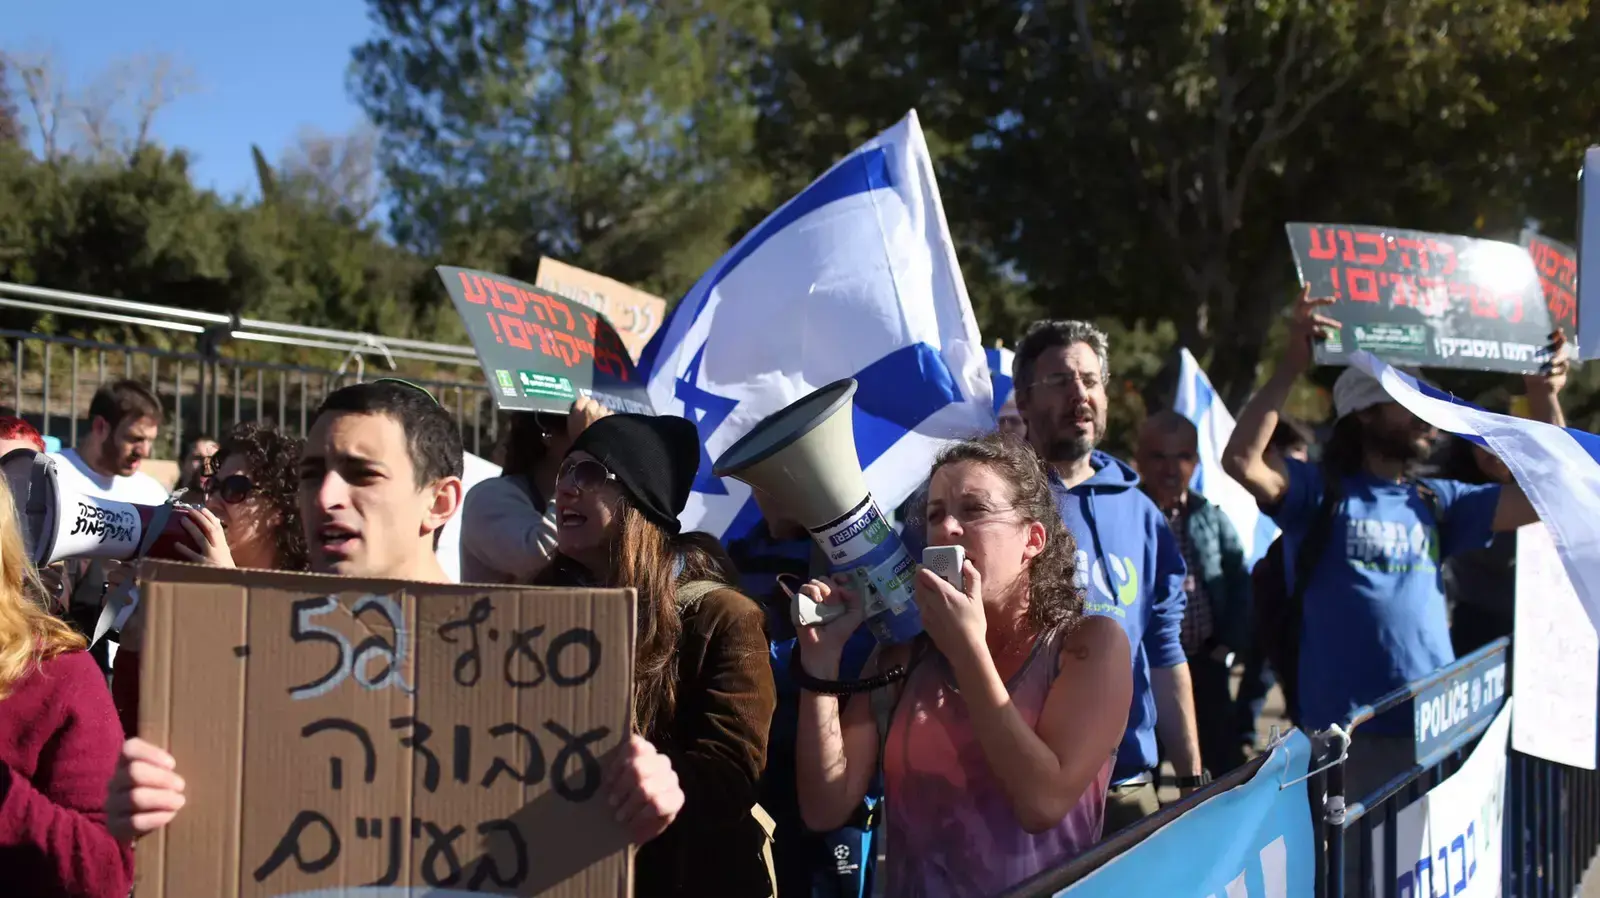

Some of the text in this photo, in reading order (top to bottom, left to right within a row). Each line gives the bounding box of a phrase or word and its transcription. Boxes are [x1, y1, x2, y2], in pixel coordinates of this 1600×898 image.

[1309, 227, 1458, 275] להיכנע
[458, 272, 576, 331] להיכנע
[486, 311, 629, 382] לטייקונים!
[1433, 336, 1501, 359] מספיק!
[70, 515, 136, 544] מתקדמת
[833, 514, 872, 545] POWER!
[437, 597, 602, 688] סעיף
[1420, 682, 1470, 742] POLICE
[301, 717, 610, 802] עבודה
[253, 809, 530, 890] בעיניים
